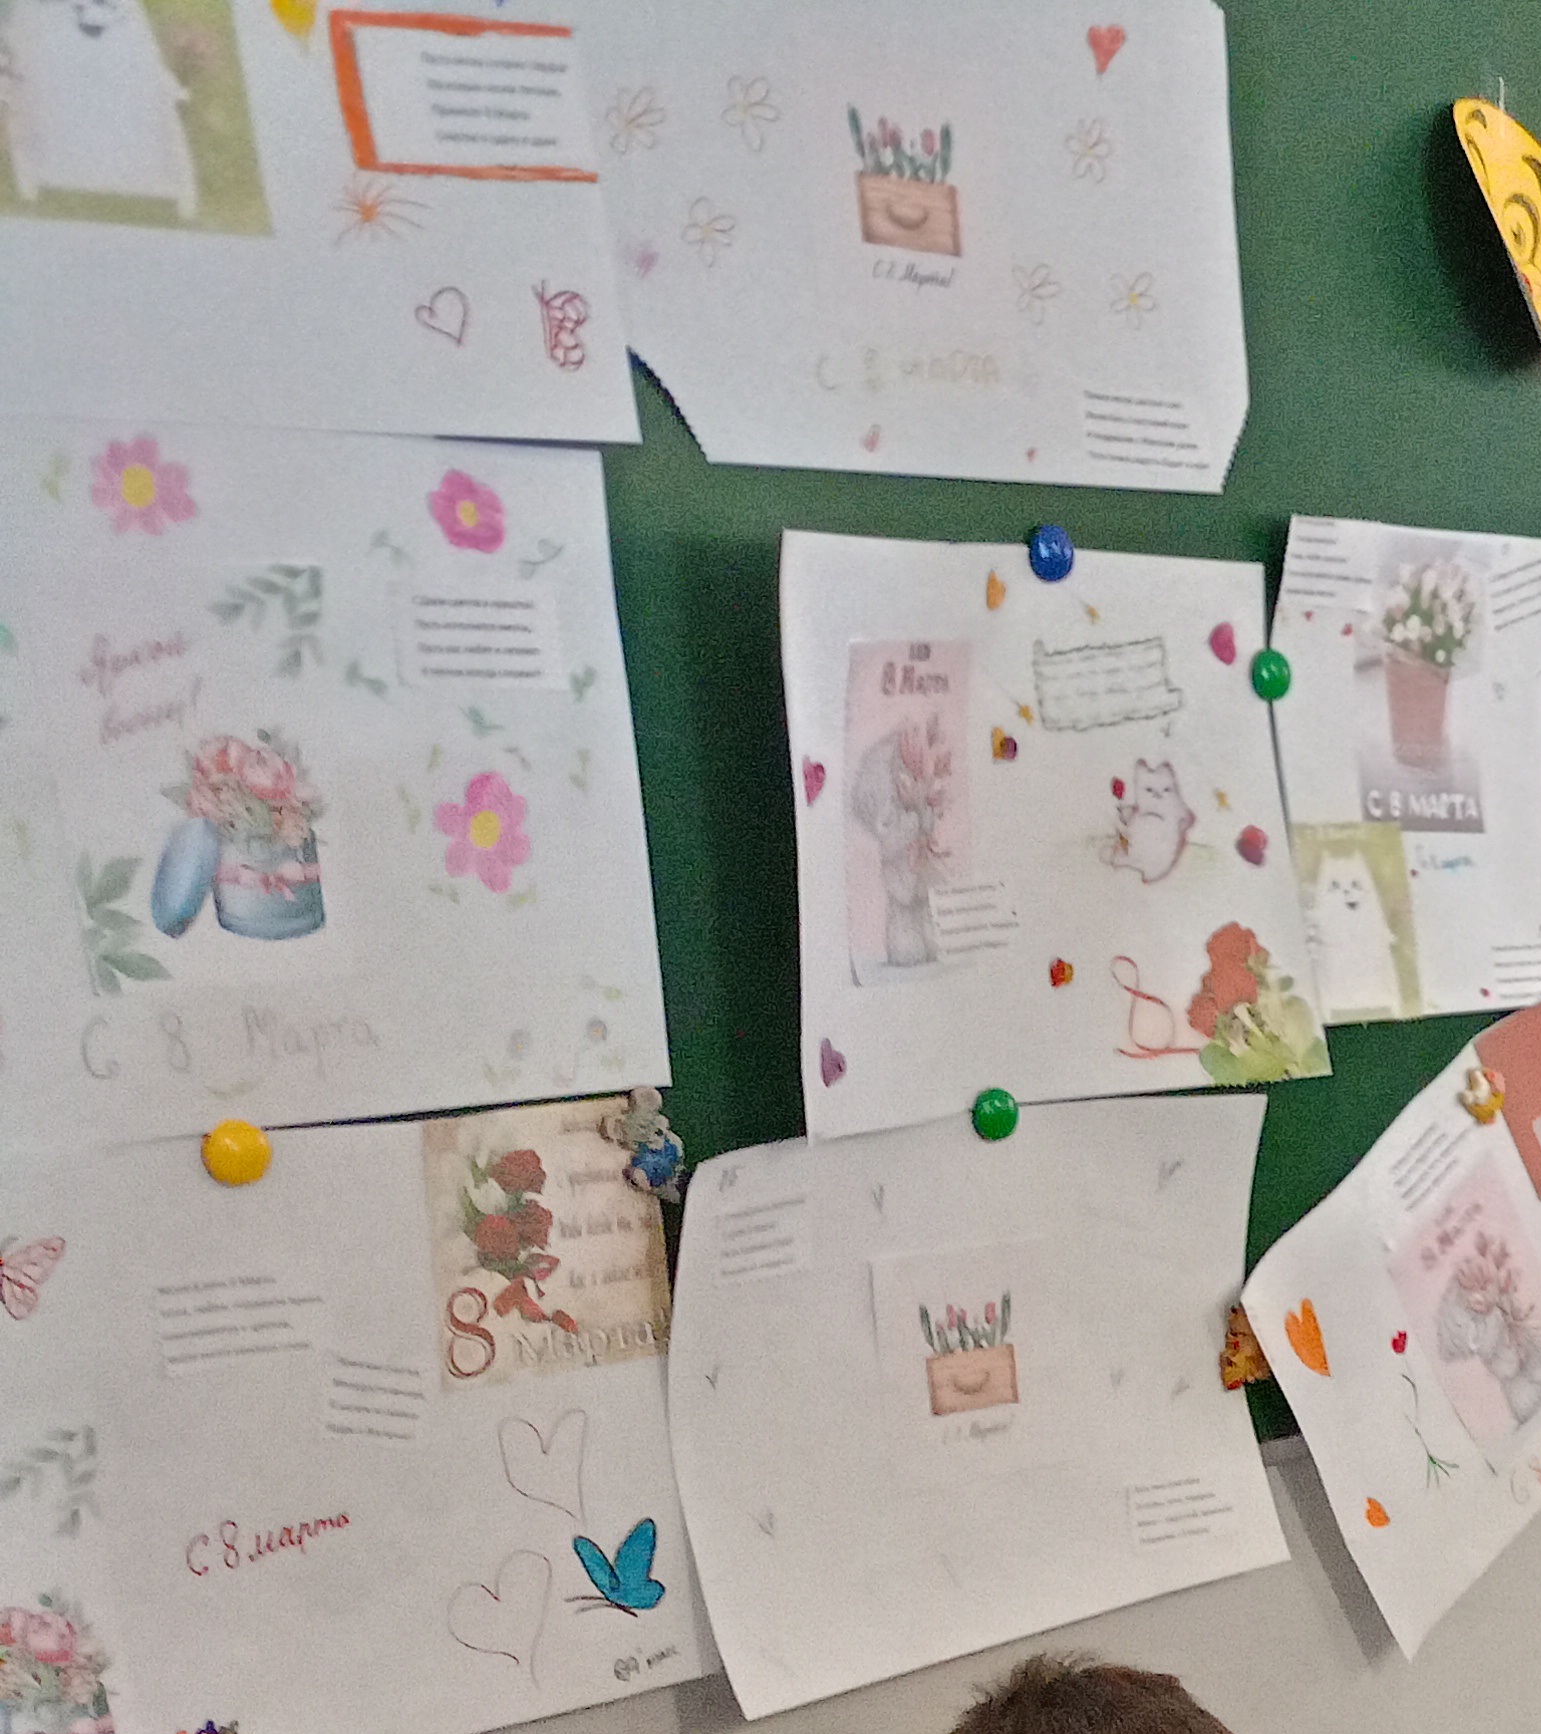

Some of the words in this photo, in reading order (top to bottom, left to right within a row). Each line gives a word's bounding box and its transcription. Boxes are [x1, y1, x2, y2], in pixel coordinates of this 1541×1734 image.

[158, 1010, 192, 1074] 8
[446, 1287, 496, 1379] 8
[219, 1519, 240, 1570] 8
